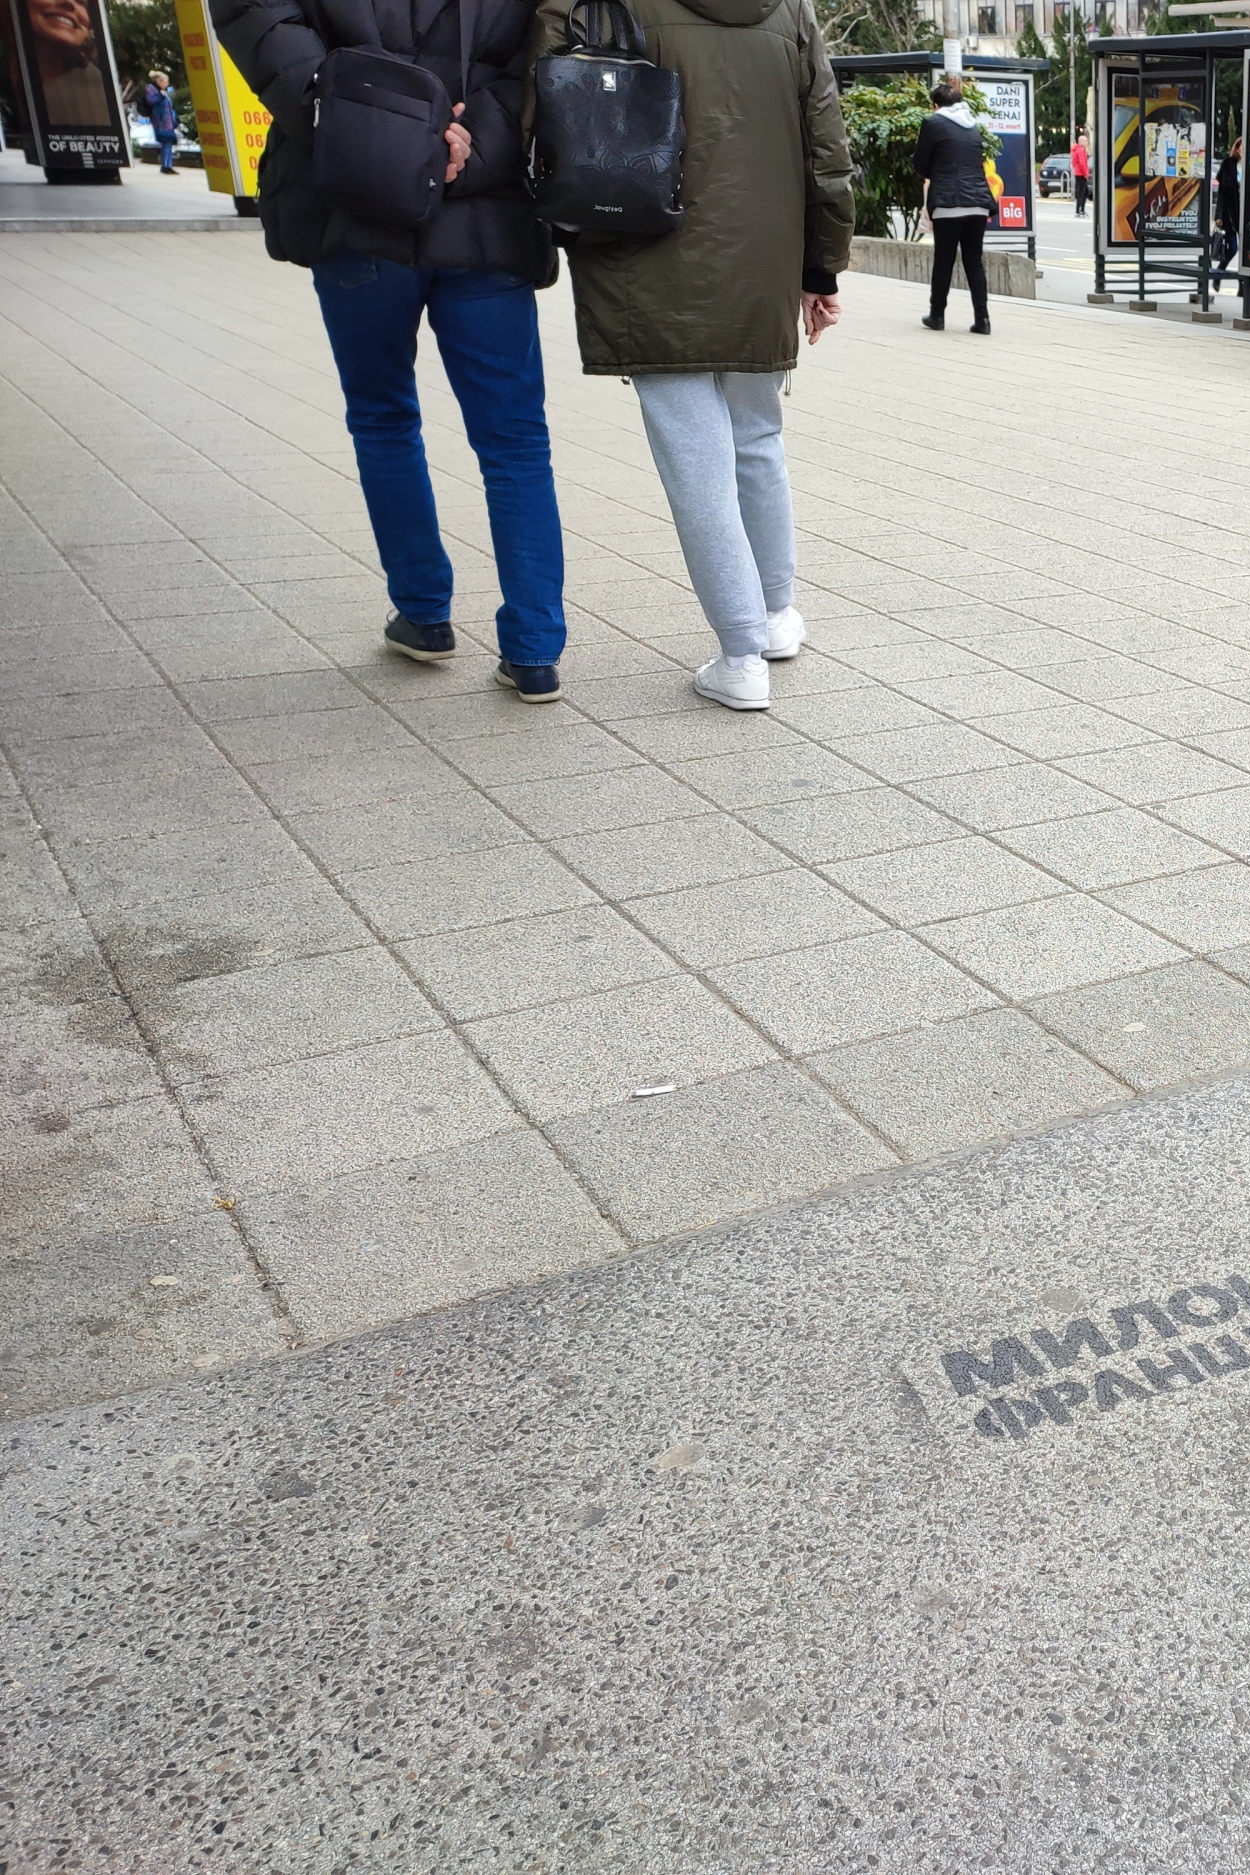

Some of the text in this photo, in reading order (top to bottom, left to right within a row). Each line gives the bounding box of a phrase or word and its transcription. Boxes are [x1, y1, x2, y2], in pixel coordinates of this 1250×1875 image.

[996, 86, 1020, 96] DANI
[990, 97, 1020, 107] SUPER
[49, 141, 119, 153] OF BEAUTY
